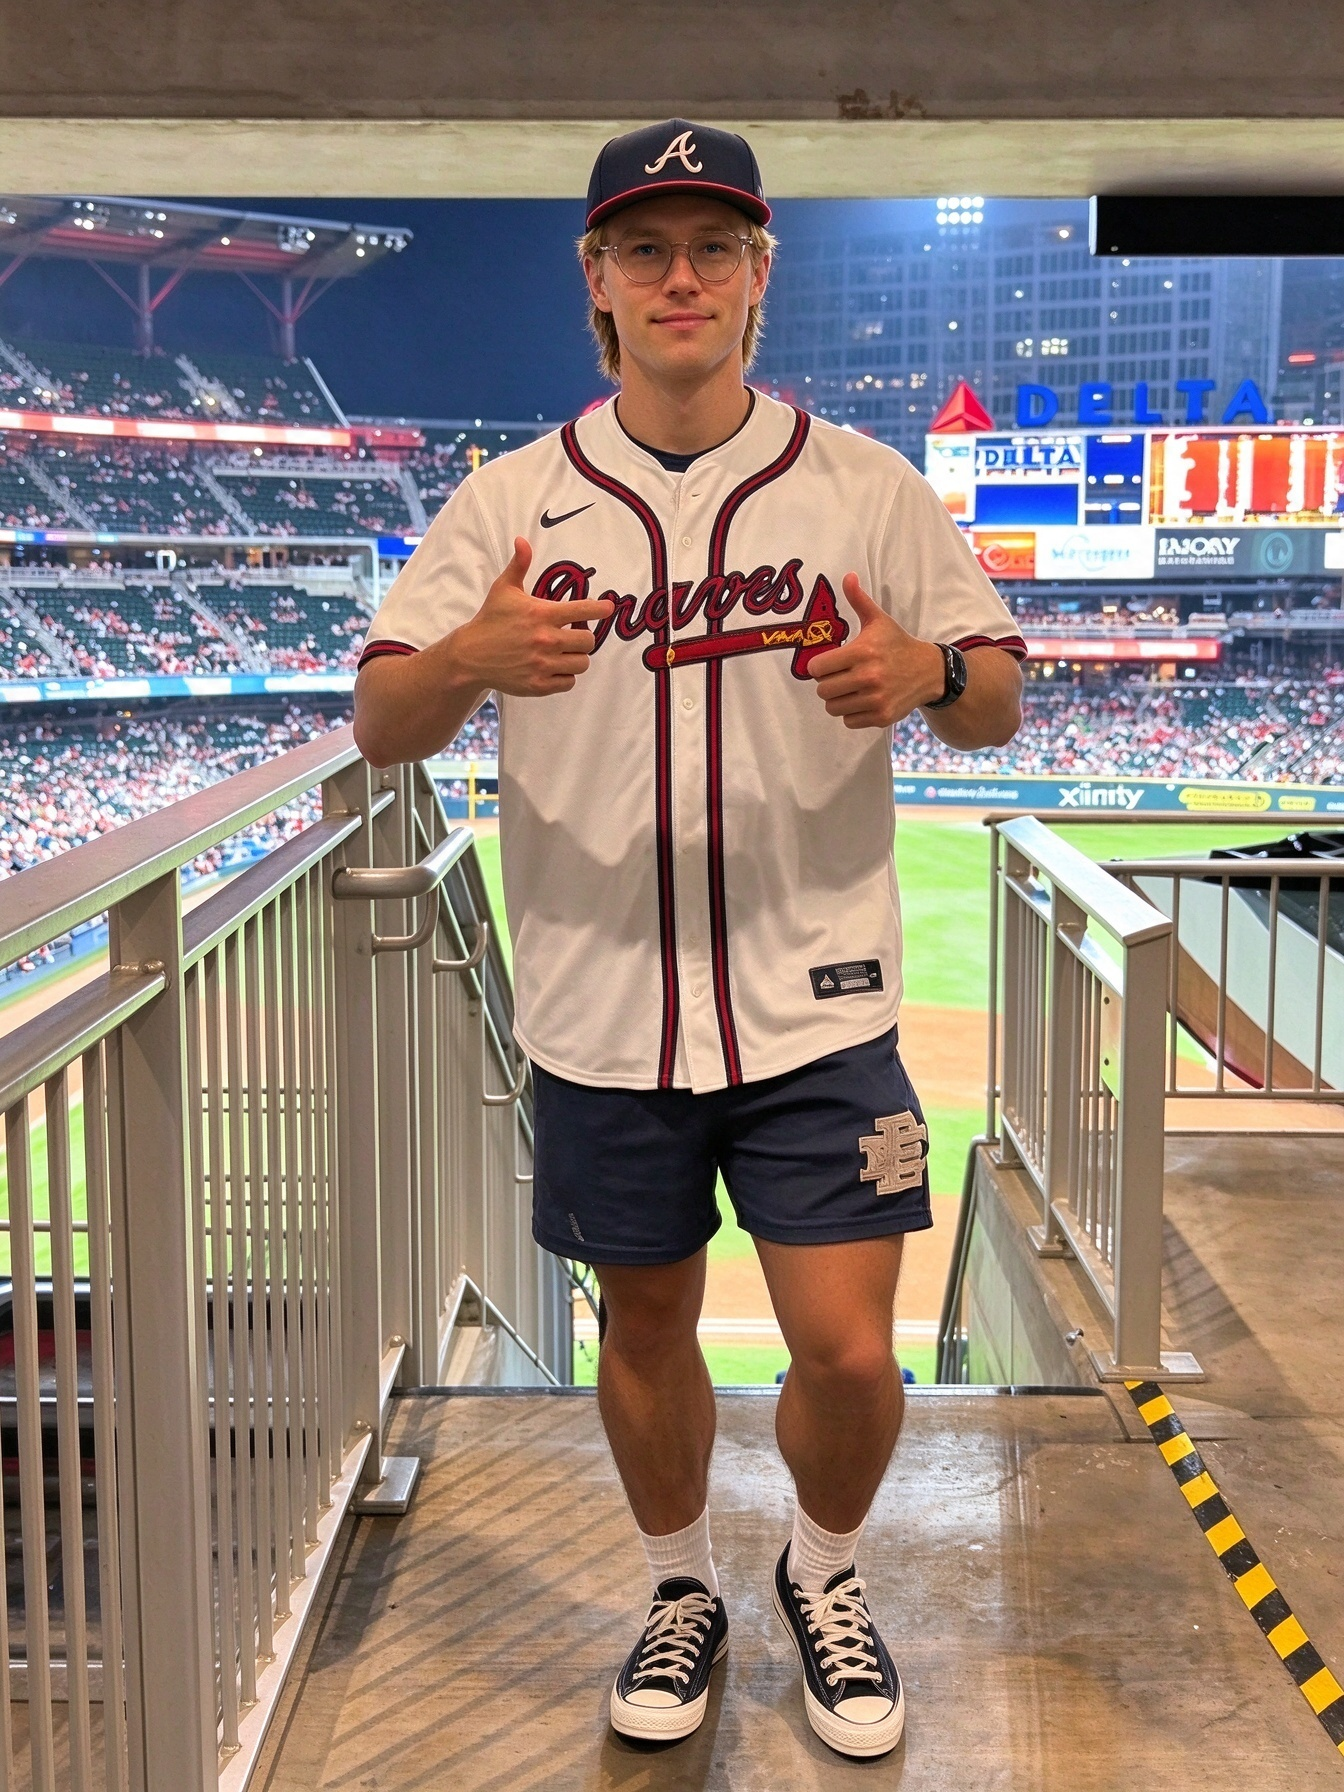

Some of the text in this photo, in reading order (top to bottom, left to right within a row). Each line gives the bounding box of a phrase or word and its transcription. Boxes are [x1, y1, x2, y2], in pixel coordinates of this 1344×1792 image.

[644, 131, 703, 174] A
[1016, 379, 1269, 427] DELTA
[984, 444, 1080, 467] DELTA
